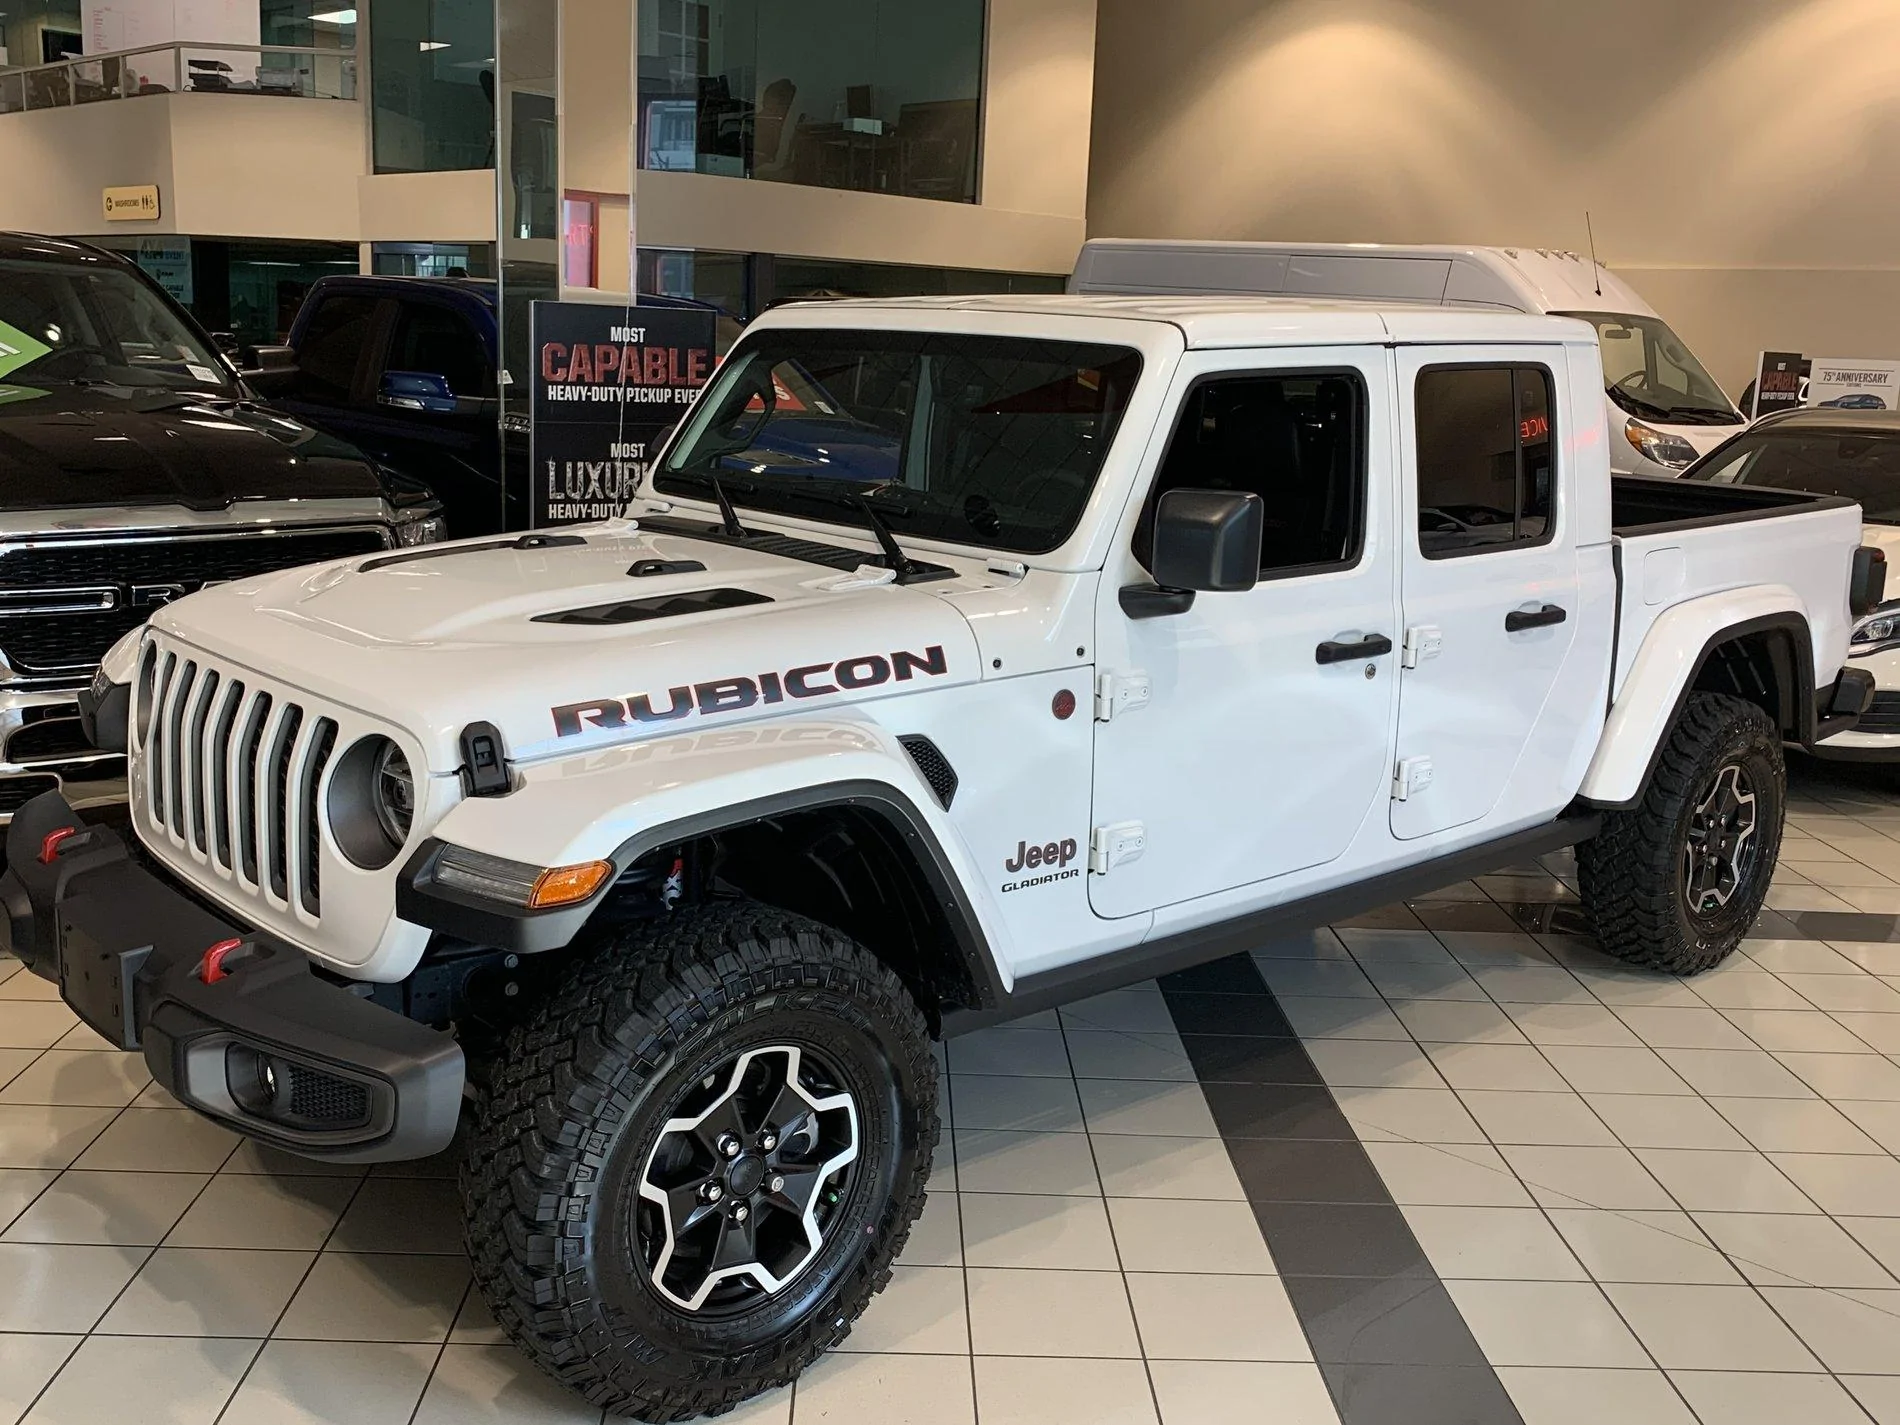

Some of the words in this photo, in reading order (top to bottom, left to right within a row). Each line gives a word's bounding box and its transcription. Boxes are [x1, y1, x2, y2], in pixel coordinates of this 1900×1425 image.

[610, 326, 646, 343] MOST
[542, 342, 707, 386] CAPABLE
[1836, 372, 1889, 384] ANNIVERSARY
[548, 385, 624, 402] HEAVY-DUTY
[626, 387, 671, 403] PICKUP
[610, 443, 645, 458] MOST
[548, 503, 624, 519] HEAVY-DUTY
[551, 645, 948, 737] RUBICON
[1006, 838, 1077, 873] Jeep
[1001, 868, 1079, 893] GLADIATOR
